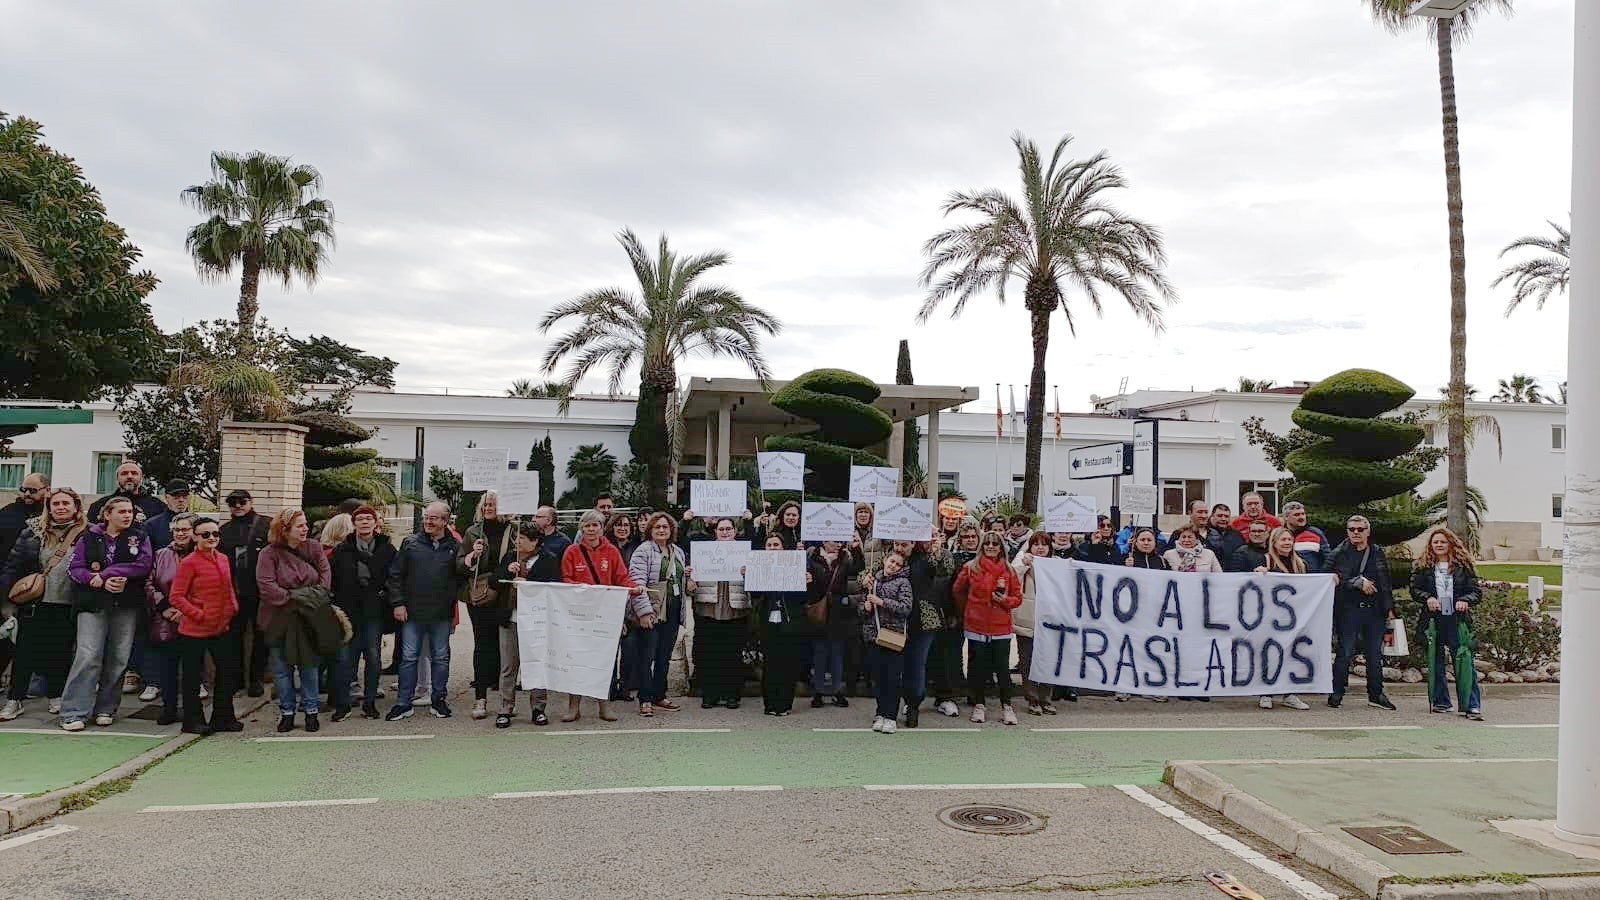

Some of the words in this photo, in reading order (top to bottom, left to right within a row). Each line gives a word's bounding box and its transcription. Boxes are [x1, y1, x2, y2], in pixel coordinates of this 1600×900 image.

[1084, 455, 1113, 467] Restaurante
[1075, 568, 1139, 623] NO
[1158, 579, 1183, 630] A
[1202, 578, 1298, 632] LOS
[1042, 622, 1315, 692] TRASLADOS
